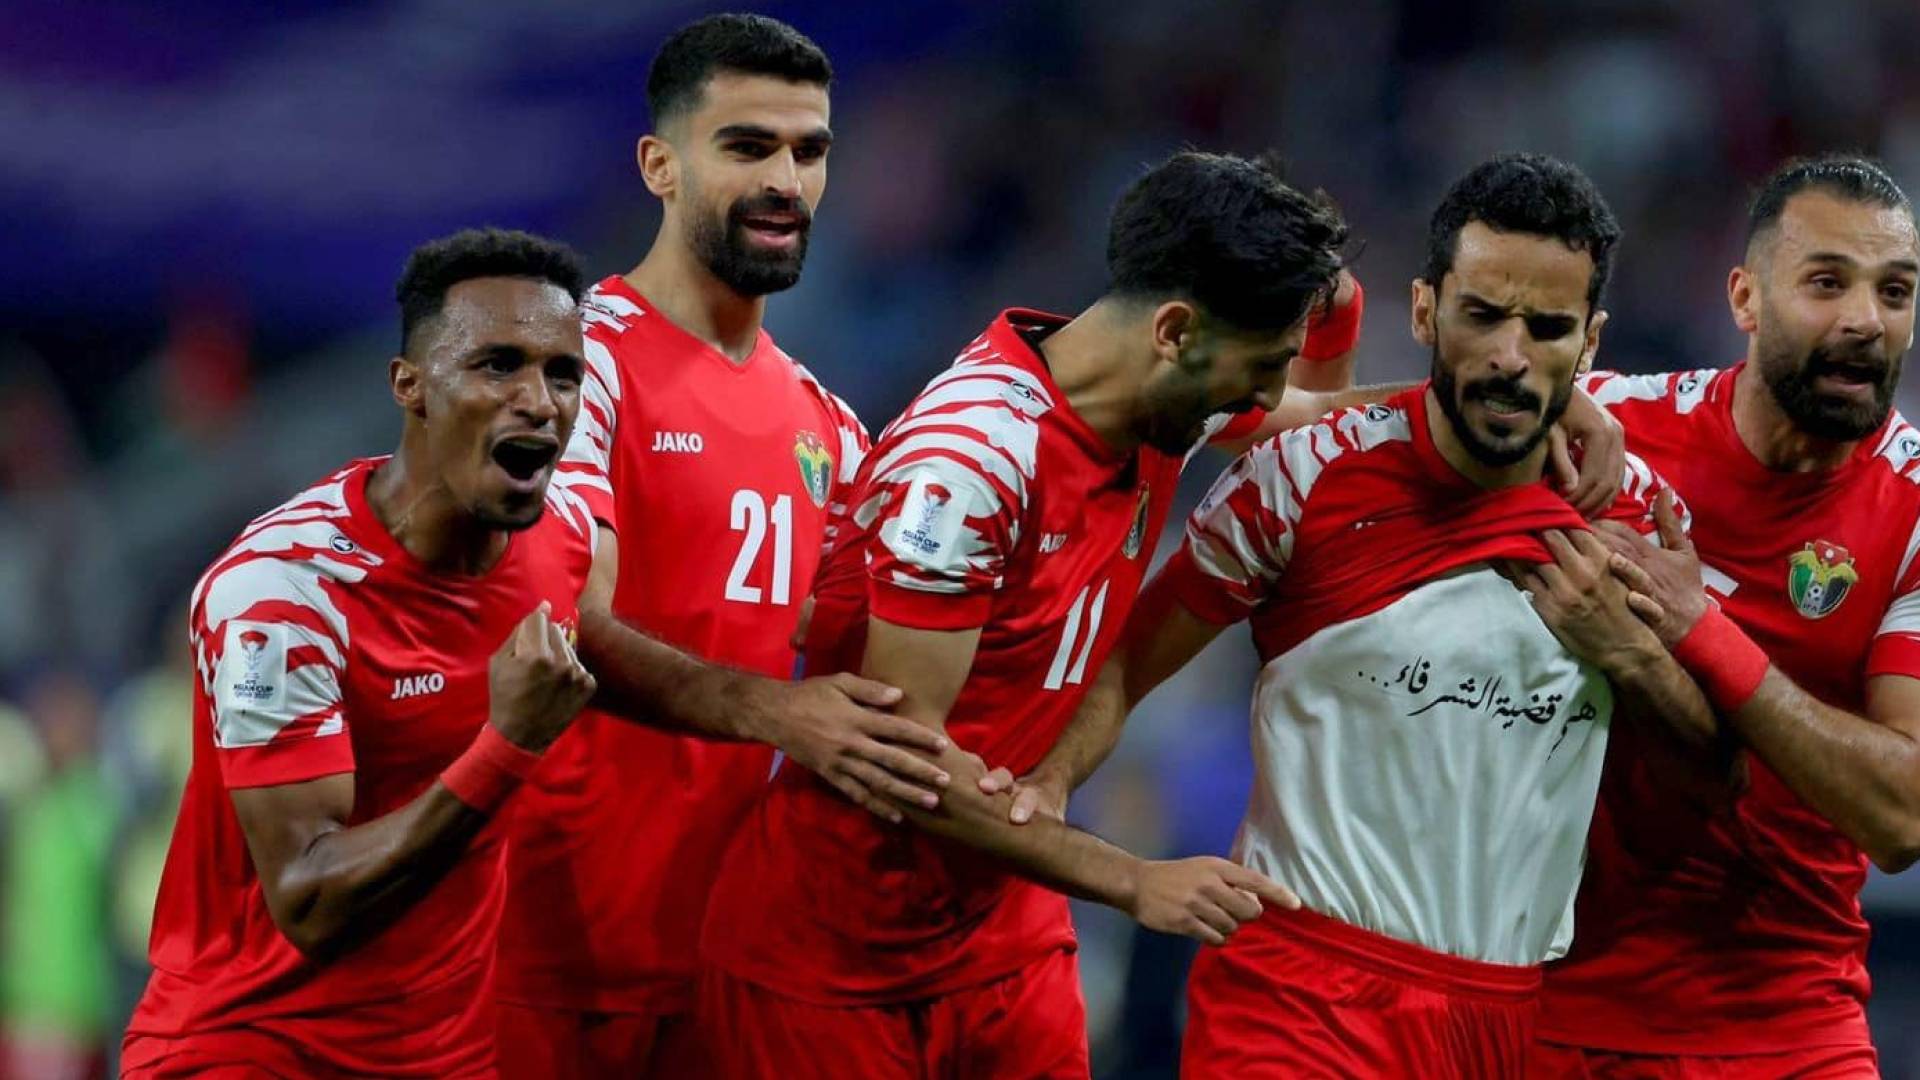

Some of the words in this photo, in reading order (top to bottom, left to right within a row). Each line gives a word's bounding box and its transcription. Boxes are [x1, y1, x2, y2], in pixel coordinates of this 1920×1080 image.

[652, 431, 704, 453] JAKO
[725, 488, 793, 606] 21
[924, 538, 941, 549] CUP
[1038, 531, 1068, 553] AKO
[1043, 578, 1110, 691] 11
[256, 685, 274, 693] CUP
[391, 672, 445, 699] JAKO
[1491, 694, 1563, 730] قضية
[1548, 701, 1597, 760] هم
